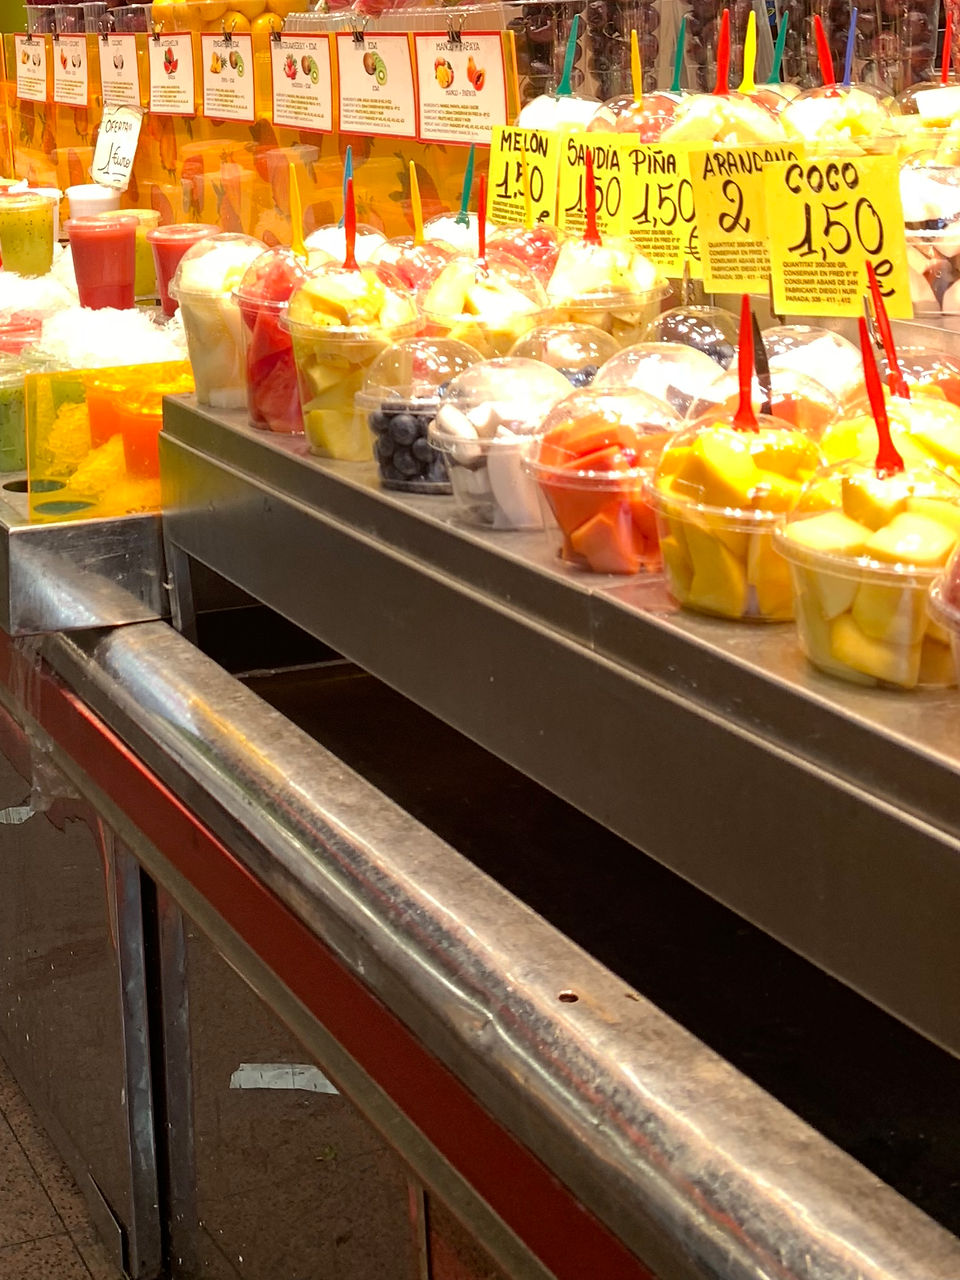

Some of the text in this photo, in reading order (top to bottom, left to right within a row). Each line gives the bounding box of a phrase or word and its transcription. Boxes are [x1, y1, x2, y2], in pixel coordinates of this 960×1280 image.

[632, 178, 697, 229] 1,50
[784, 161, 860, 194] COCO
[718, 179, 752, 234] 2
[787, 196, 885, 261] 1,50
